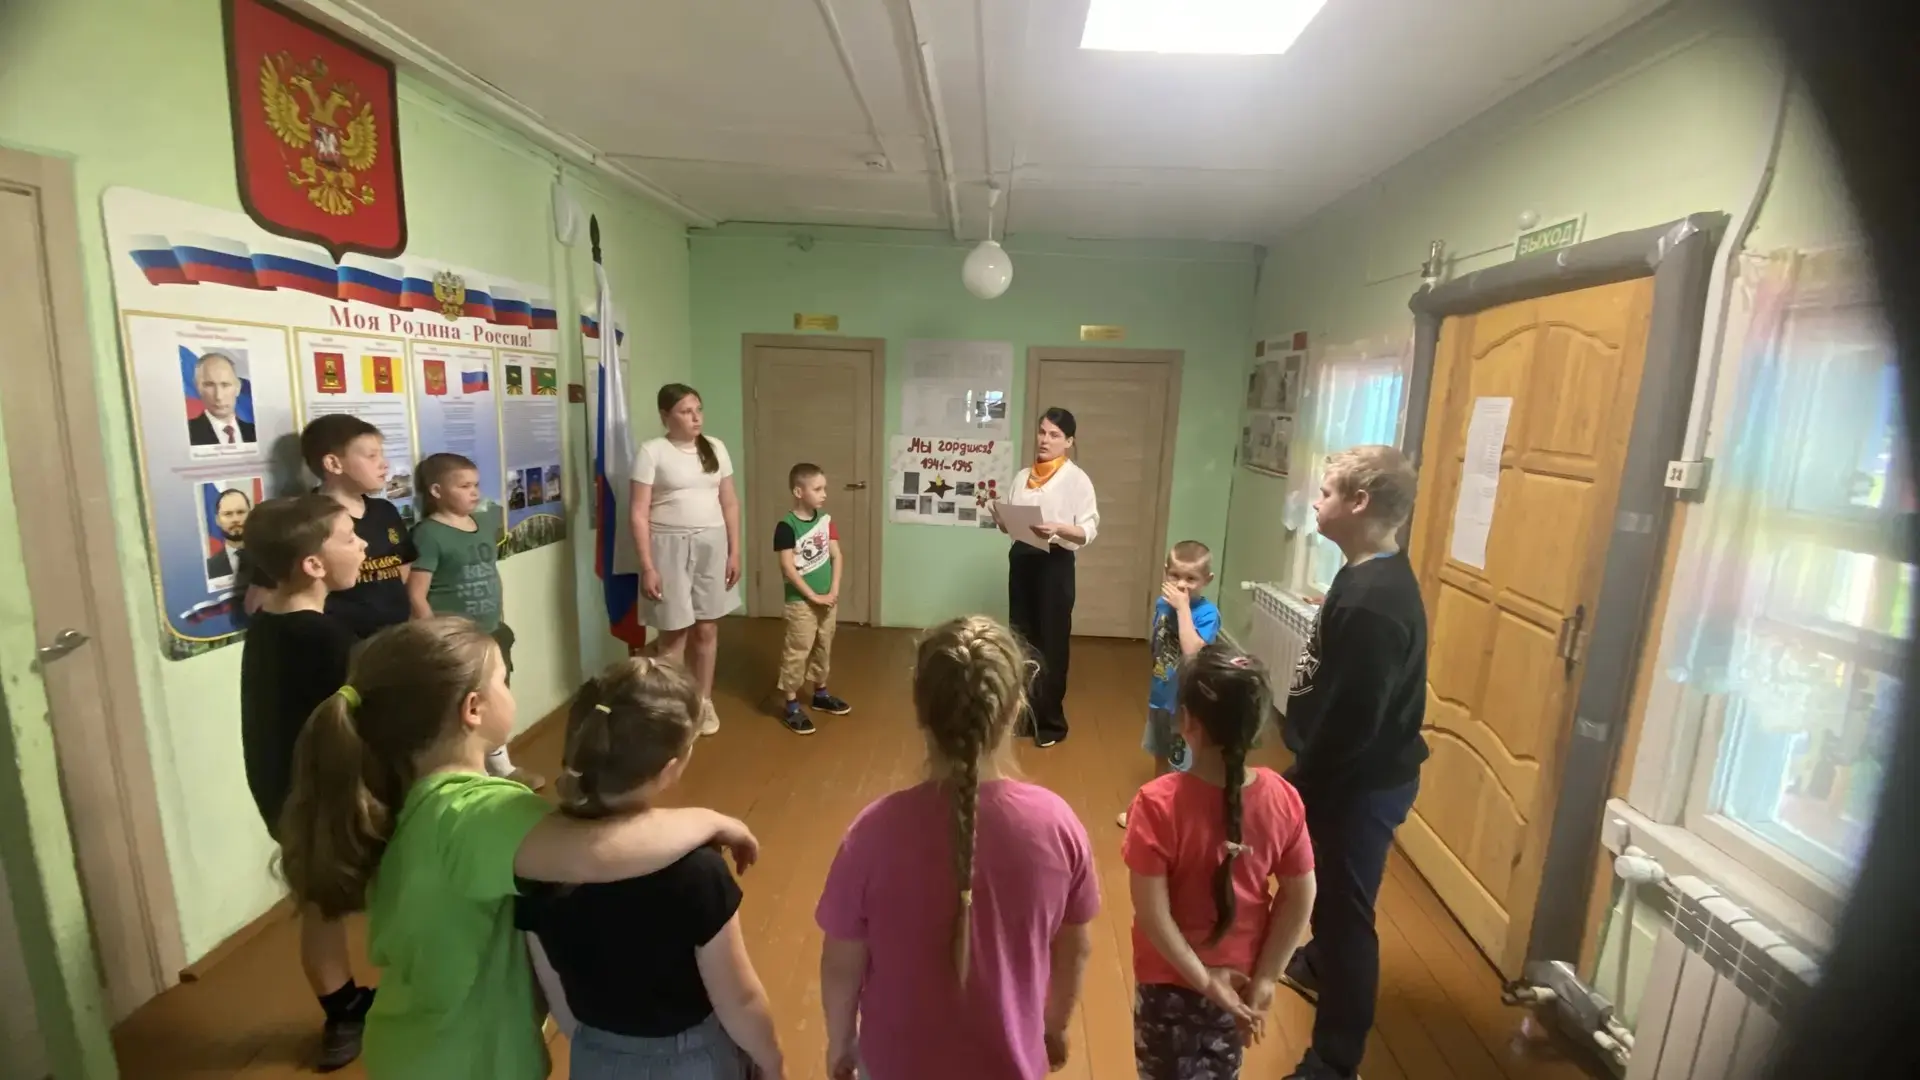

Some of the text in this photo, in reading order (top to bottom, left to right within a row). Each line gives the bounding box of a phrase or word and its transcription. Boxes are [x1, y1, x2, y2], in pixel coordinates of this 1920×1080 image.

[1519, 223, 1573, 256] ВЫХОД
[329, 305, 380, 331] Моя
[907, 437, 932, 454] Мы
